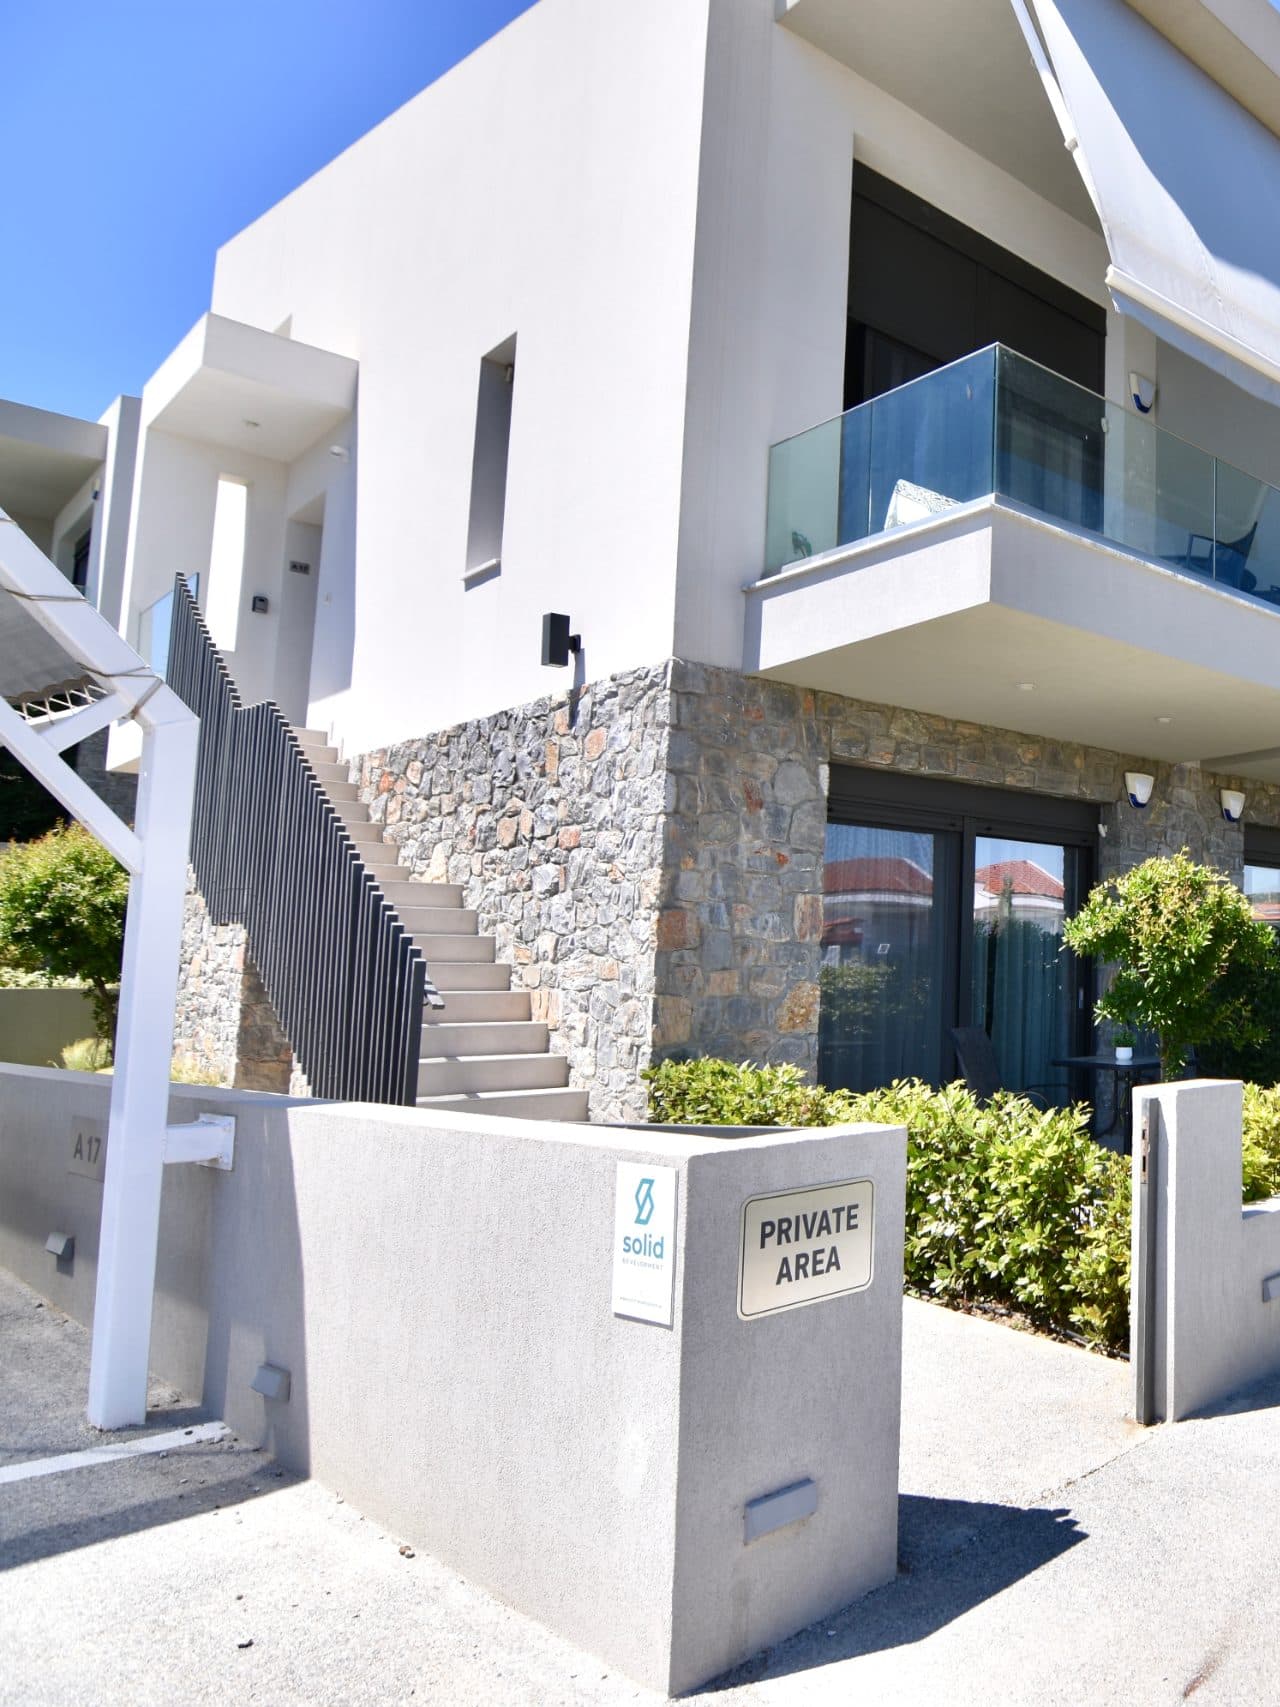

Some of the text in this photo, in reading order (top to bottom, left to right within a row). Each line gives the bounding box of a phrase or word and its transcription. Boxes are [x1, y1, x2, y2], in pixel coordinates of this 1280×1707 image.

[622, 1233, 665, 1259] solid
[760, 1204, 859, 1249] PRIVATE
[775, 1246, 841, 1286] AREA
